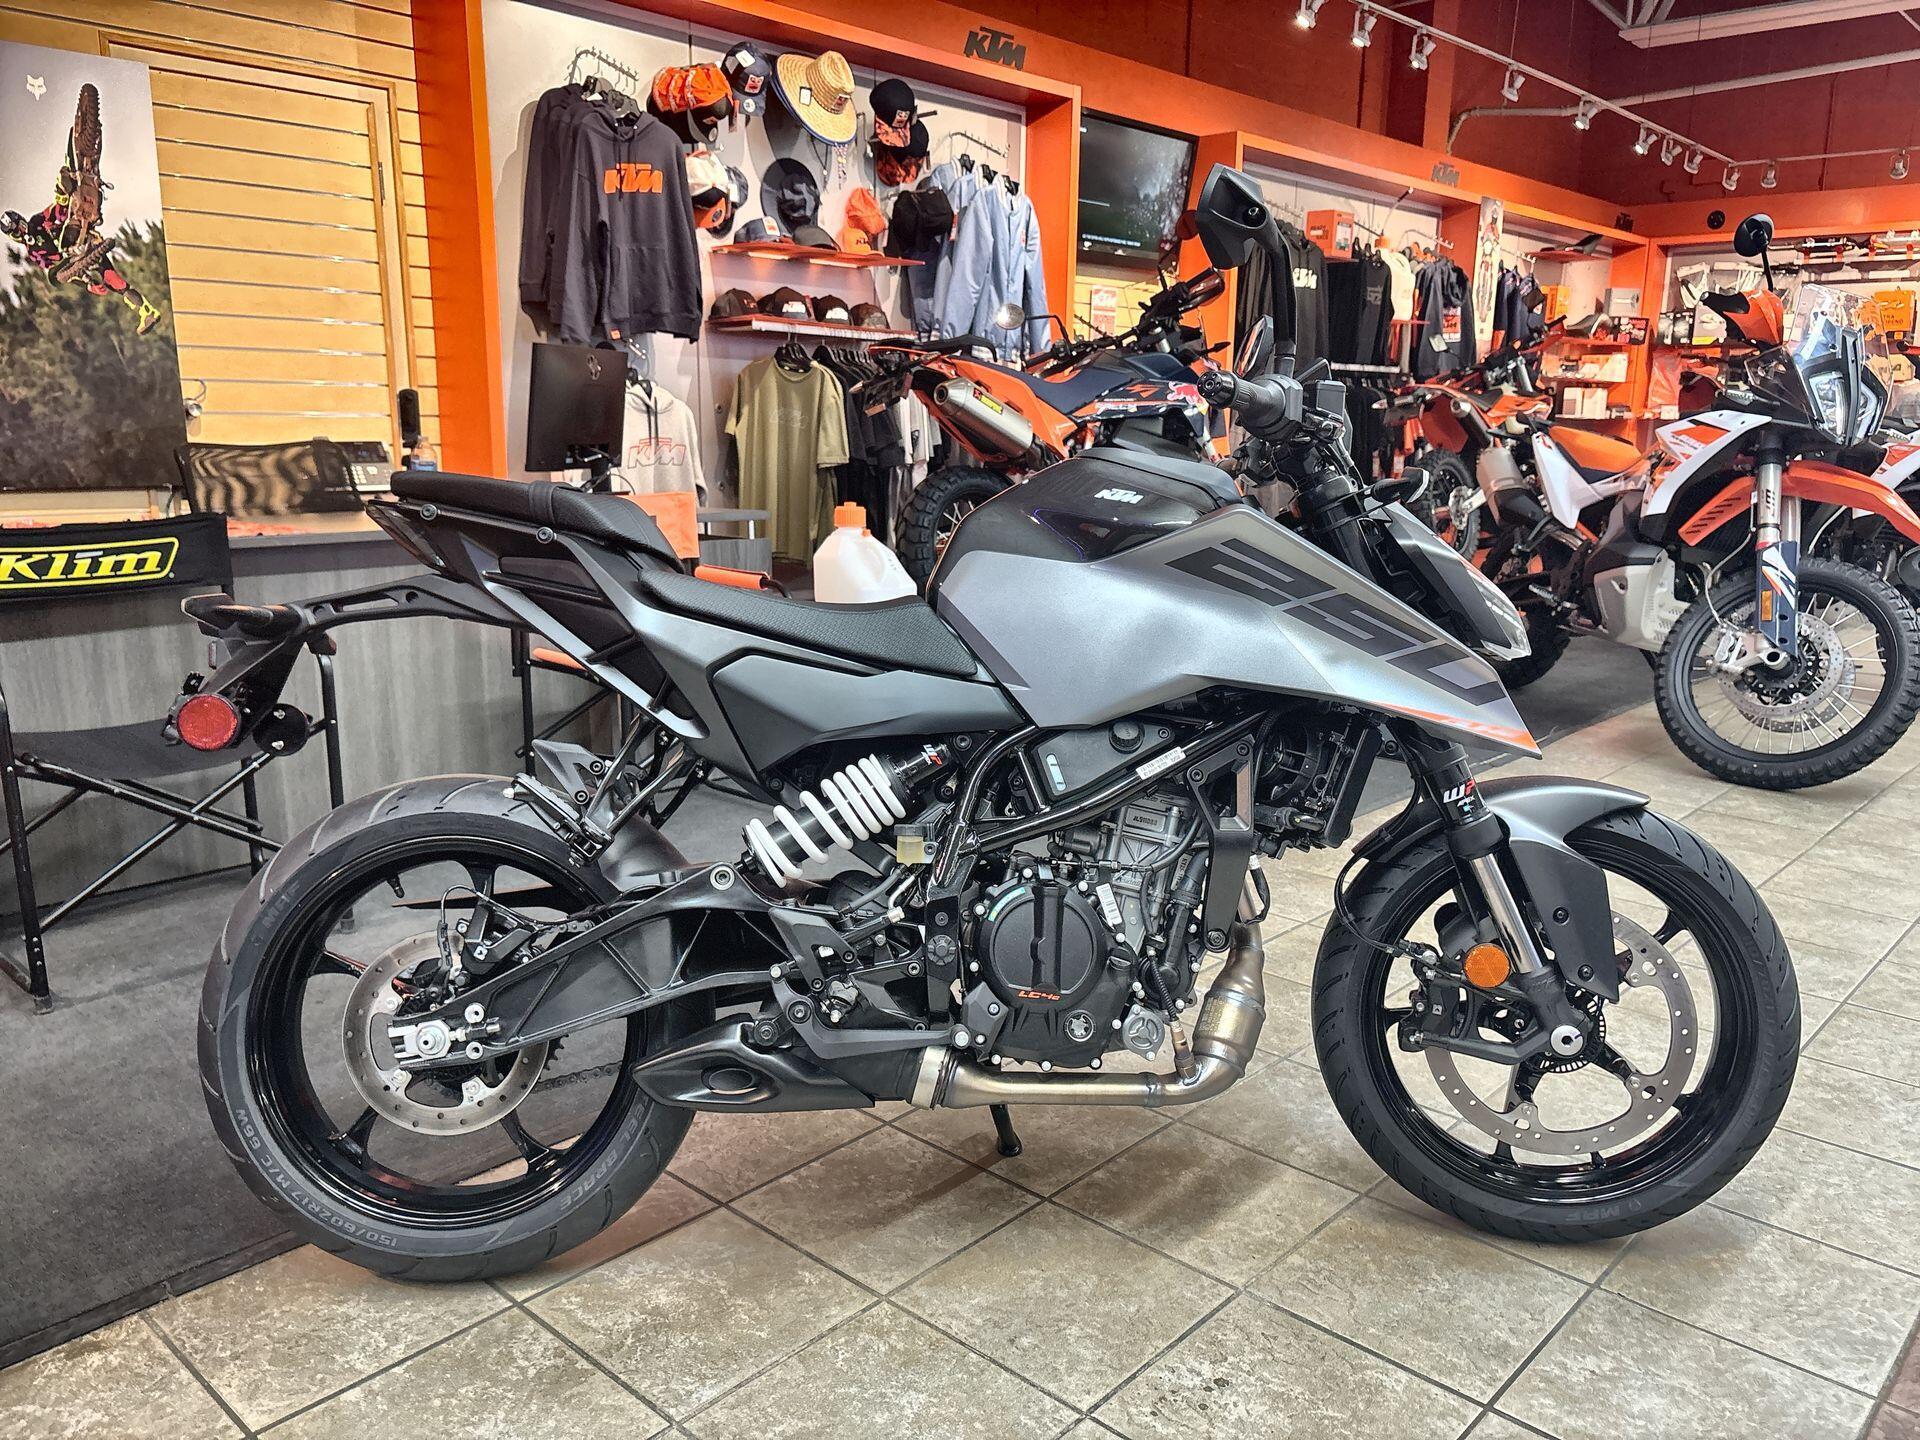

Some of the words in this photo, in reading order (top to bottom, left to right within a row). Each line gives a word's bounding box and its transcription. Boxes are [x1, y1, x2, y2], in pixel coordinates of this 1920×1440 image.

[964, 26, 1026, 71] KTM
[604, 163, 663, 194] KTM
[1431, 161, 1460, 188] KTM
[627, 436, 687, 469] KTM
[1094, 488, 1144, 504] KTM
[1443, 778, 1476, 803] WP
[235, 1108, 261, 1150] 66W
[260, 1154, 293, 1189] M/C
[560, 1149, 618, 1210] BRACE
[290, 1189, 398, 1248] 150/60ZR17
[1566, 1205, 1620, 1221] MRF
